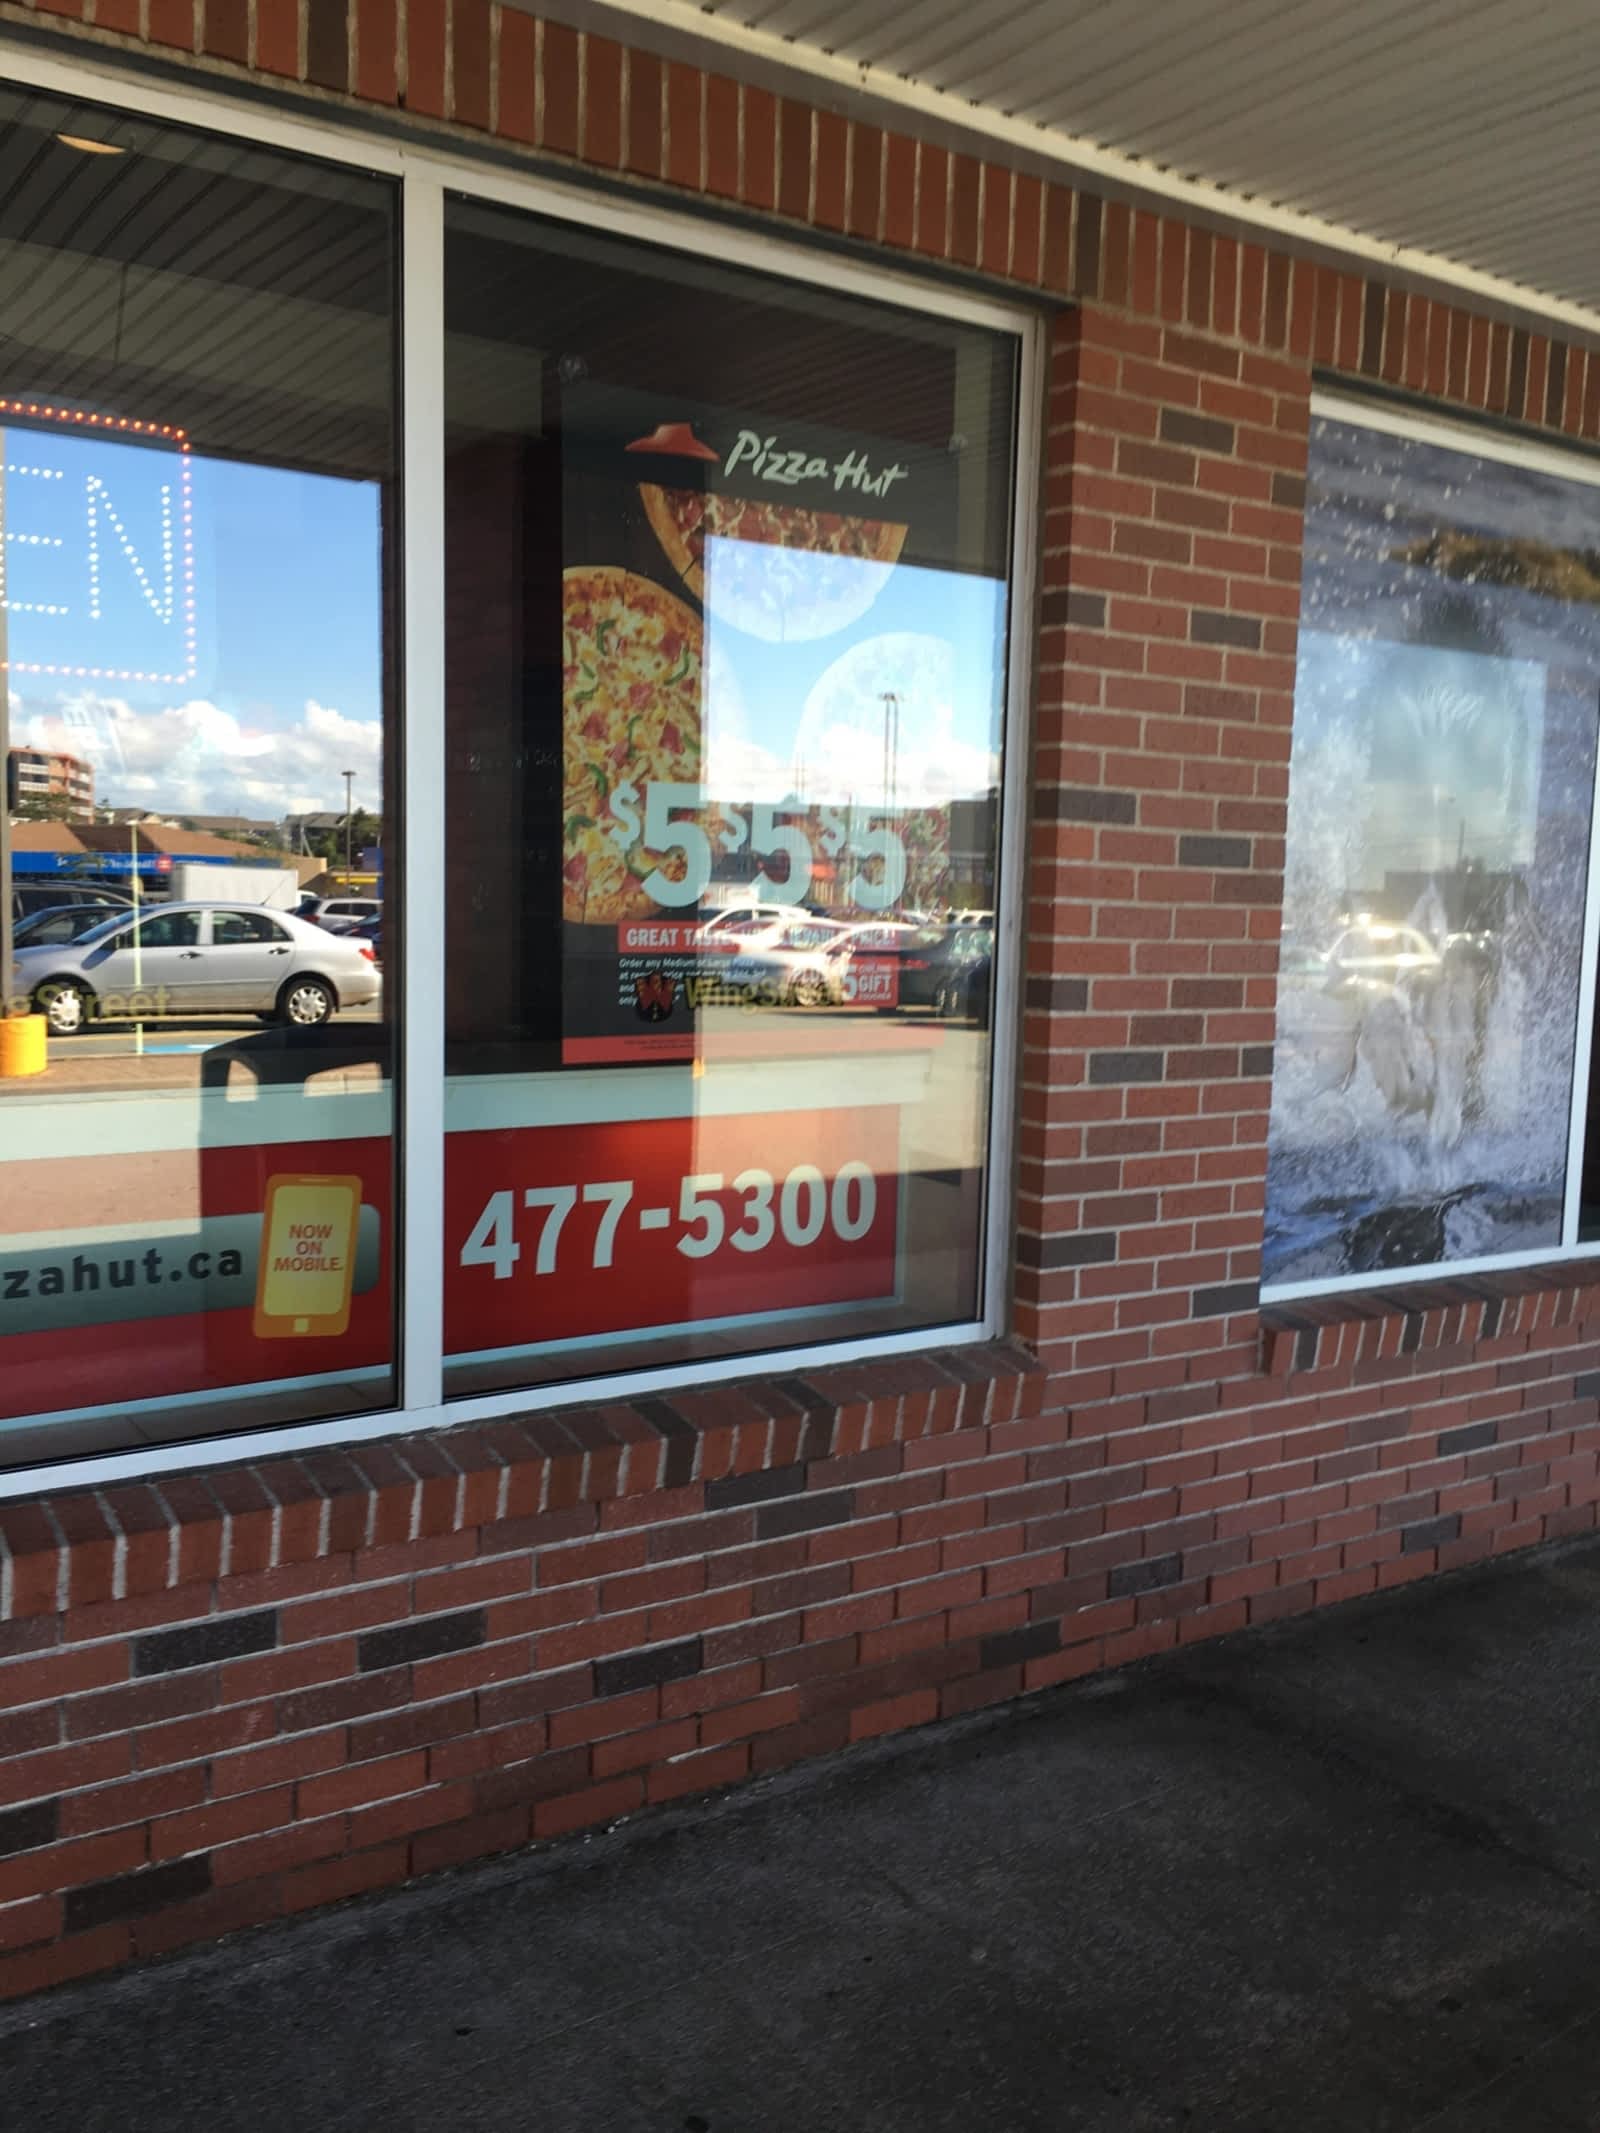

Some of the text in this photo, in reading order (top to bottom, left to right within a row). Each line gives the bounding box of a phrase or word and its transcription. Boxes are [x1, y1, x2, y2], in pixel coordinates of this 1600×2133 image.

[724, 429, 909, 498] Pizza Hut
[626, 927, 679, 947] GREAT
[859, 975, 891, 993] GIFT
[460, 1161, 877, 1279] 477-5300
[288, 1224, 333, 1239] NOW
[296, 1241, 322, 1255] ON
